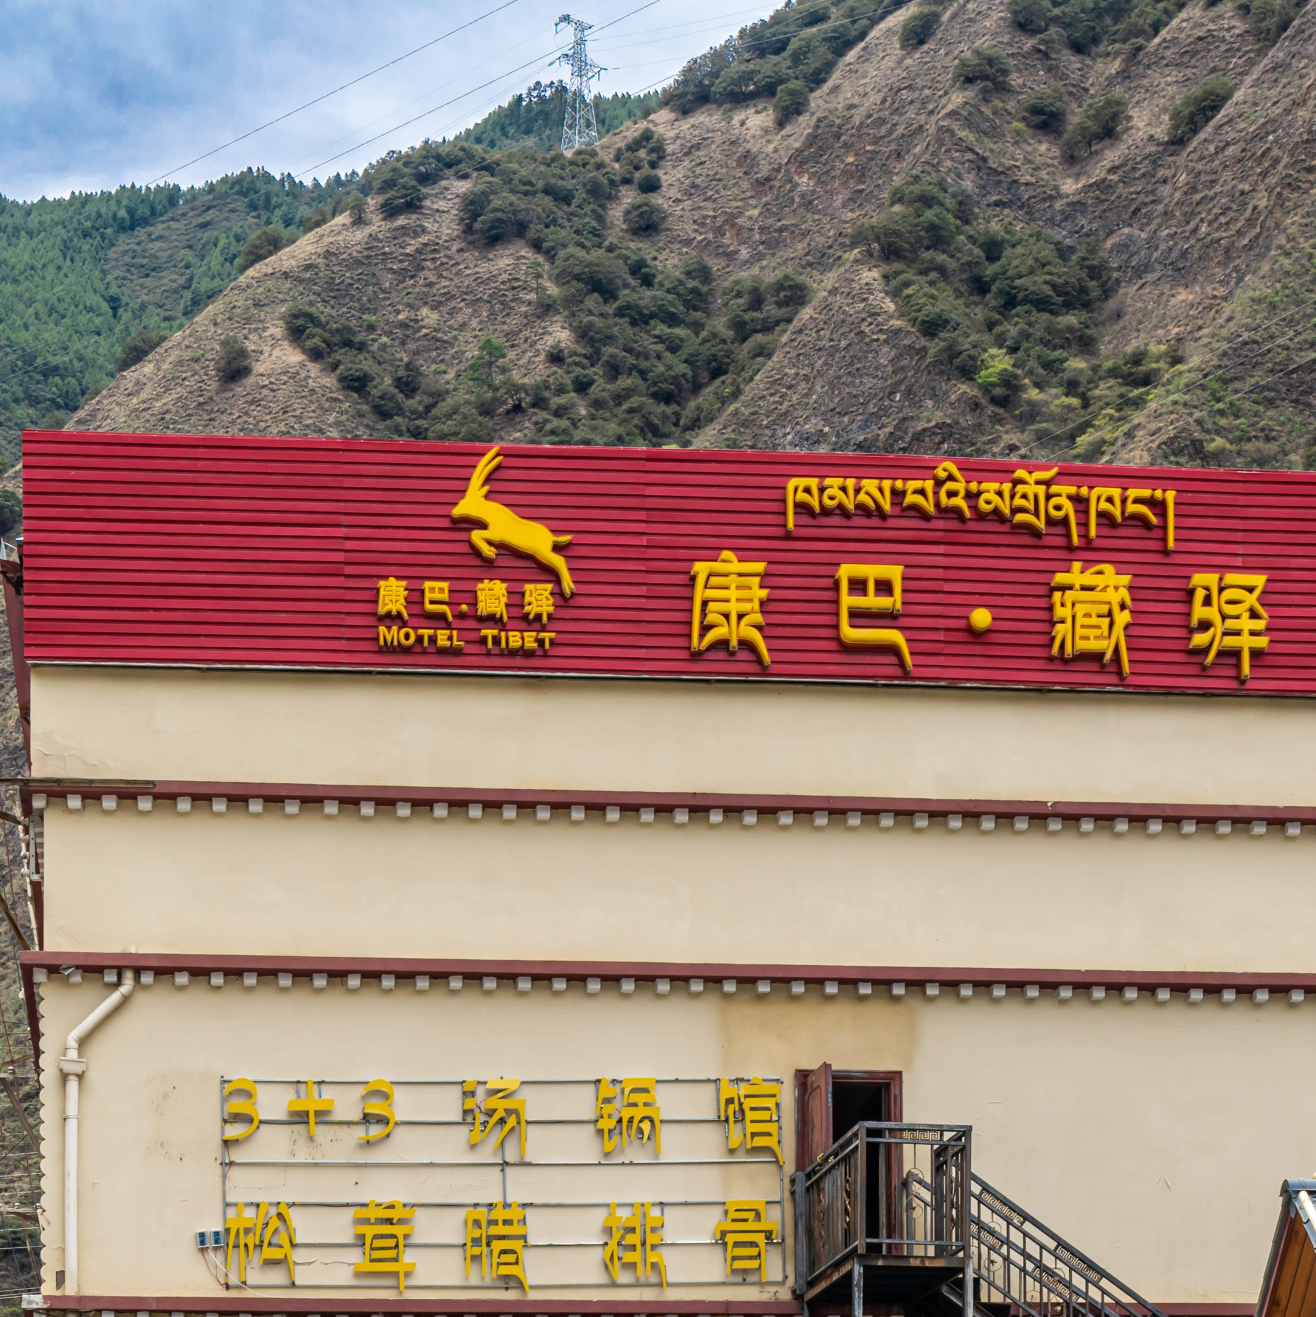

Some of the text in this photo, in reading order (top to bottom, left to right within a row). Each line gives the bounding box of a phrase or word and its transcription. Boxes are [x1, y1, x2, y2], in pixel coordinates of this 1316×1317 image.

[378, 626, 556, 650] MOTEL TIBET
[225, 1200, 779, 1293] 松茸腊排骨
